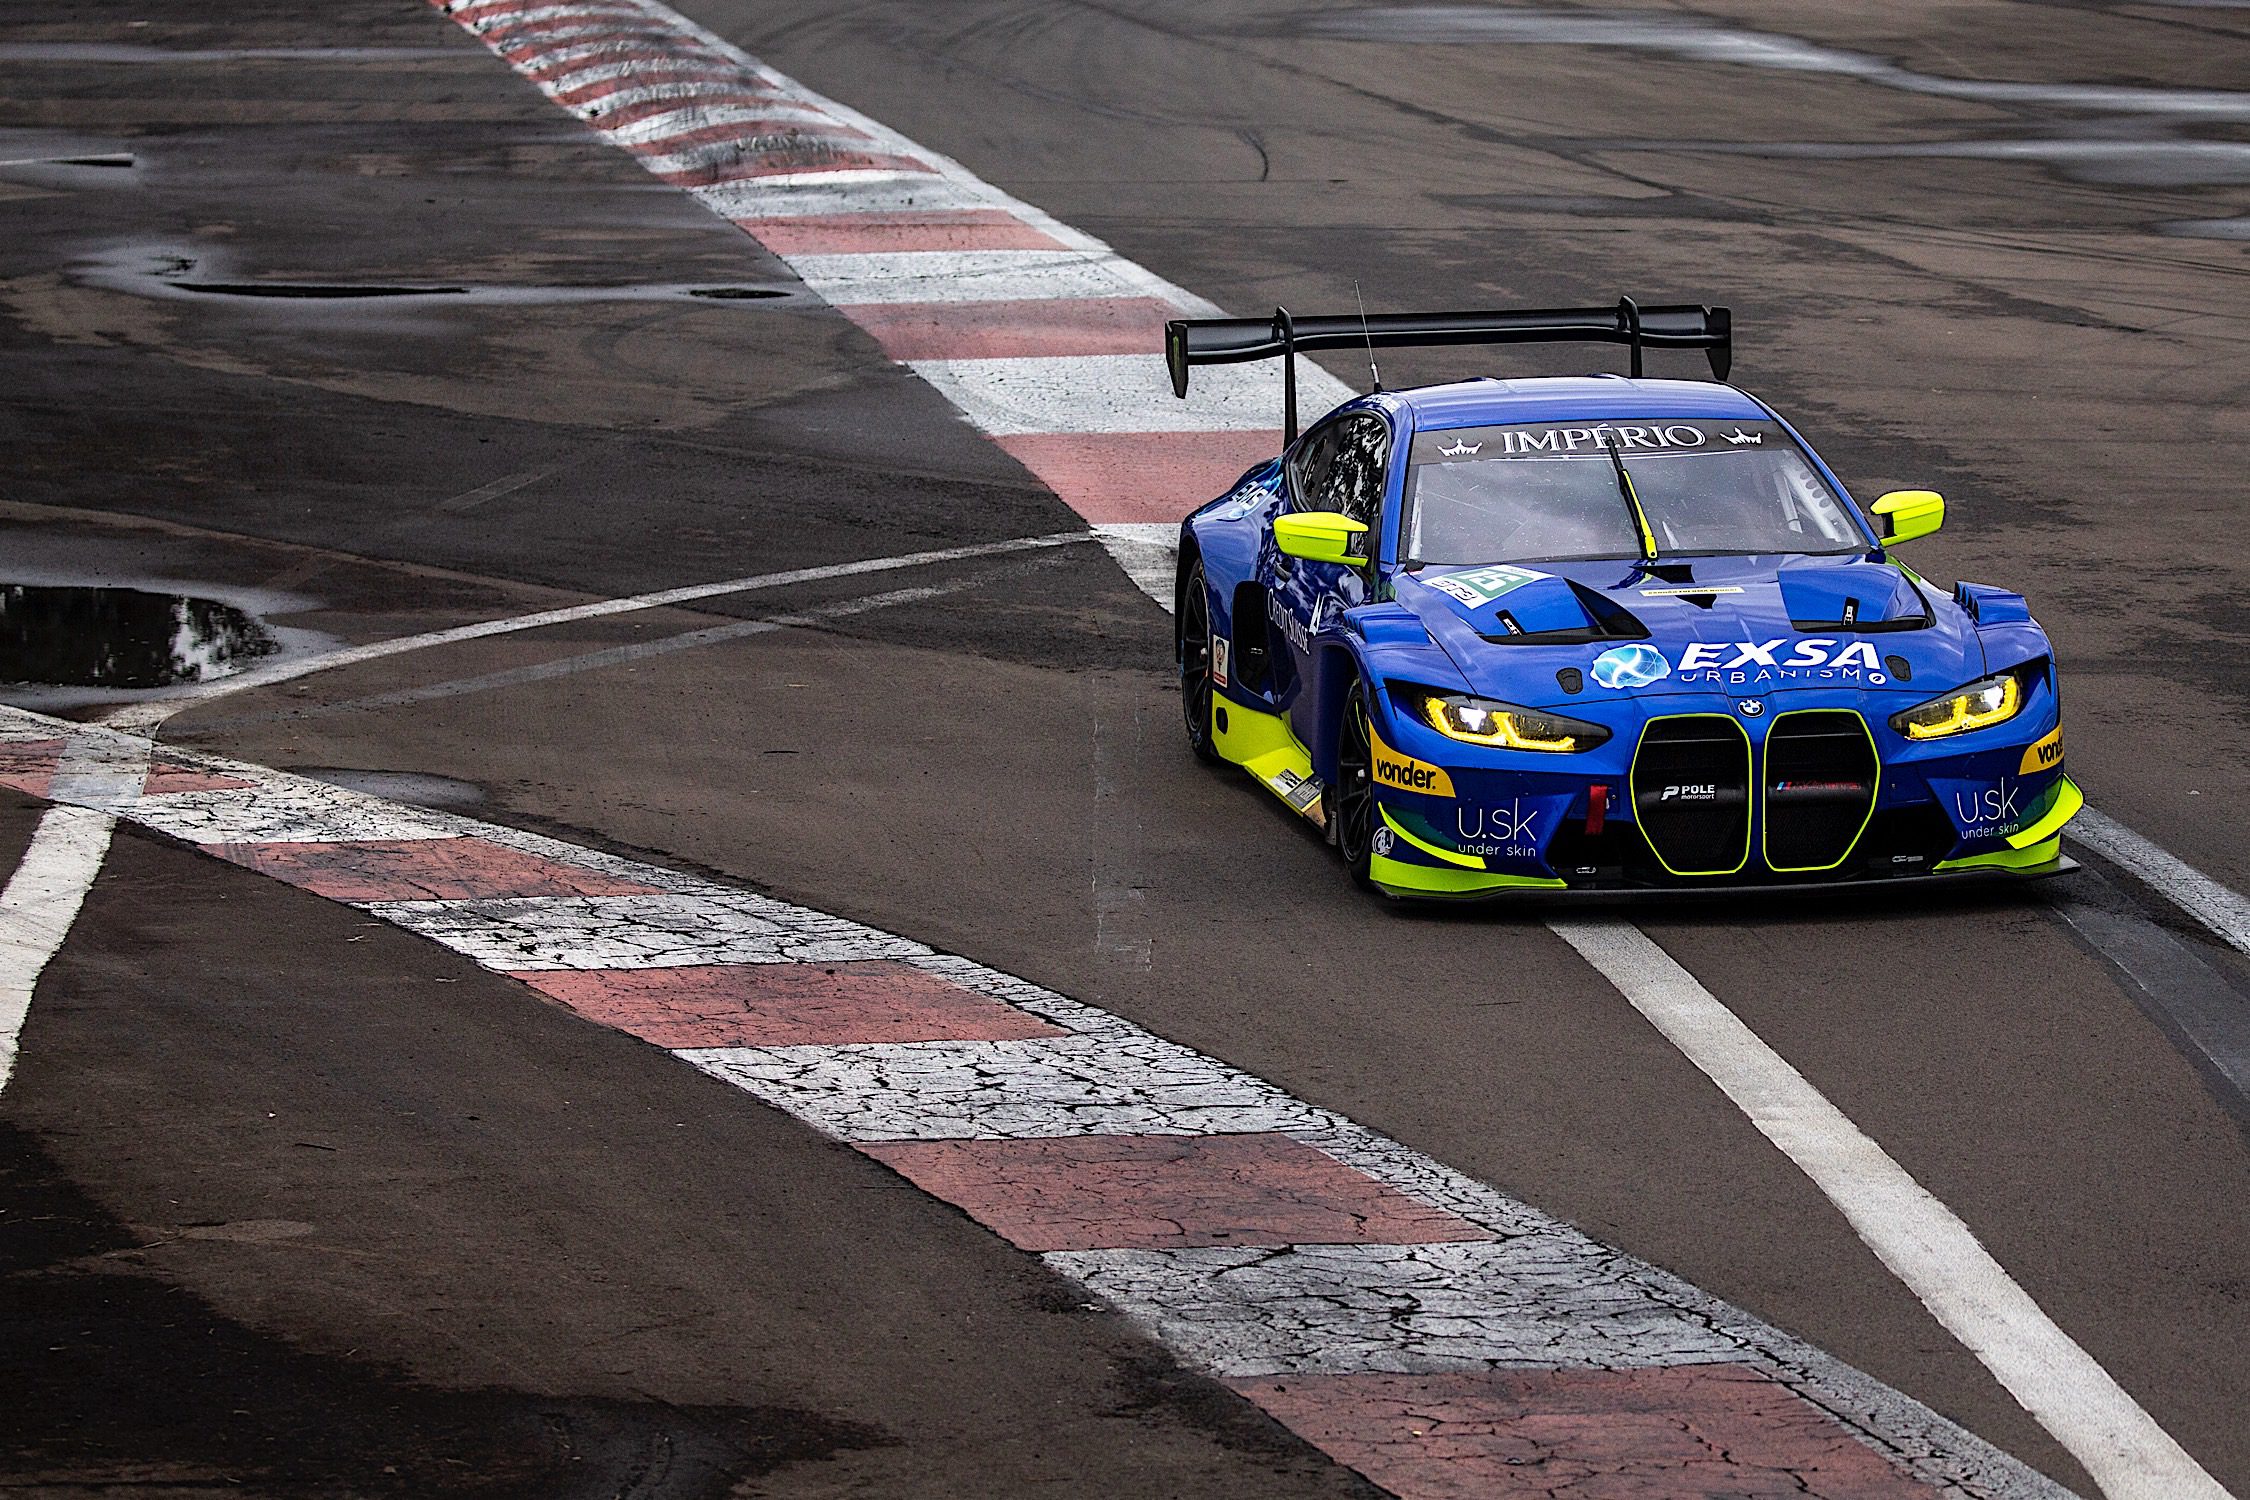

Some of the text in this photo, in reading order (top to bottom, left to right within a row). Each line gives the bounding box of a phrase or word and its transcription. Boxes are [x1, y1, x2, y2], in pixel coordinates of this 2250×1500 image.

[1501, 423, 1706, 454] IMPÉRIO
[1677, 638, 1881, 671] EXSA
[1680, 668, 1887, 685] URBANISMO
[1681, 784, 1716, 795] POLE
[1961, 822, 2020, 840] under skin
[1457, 842, 1537, 857] under skin
